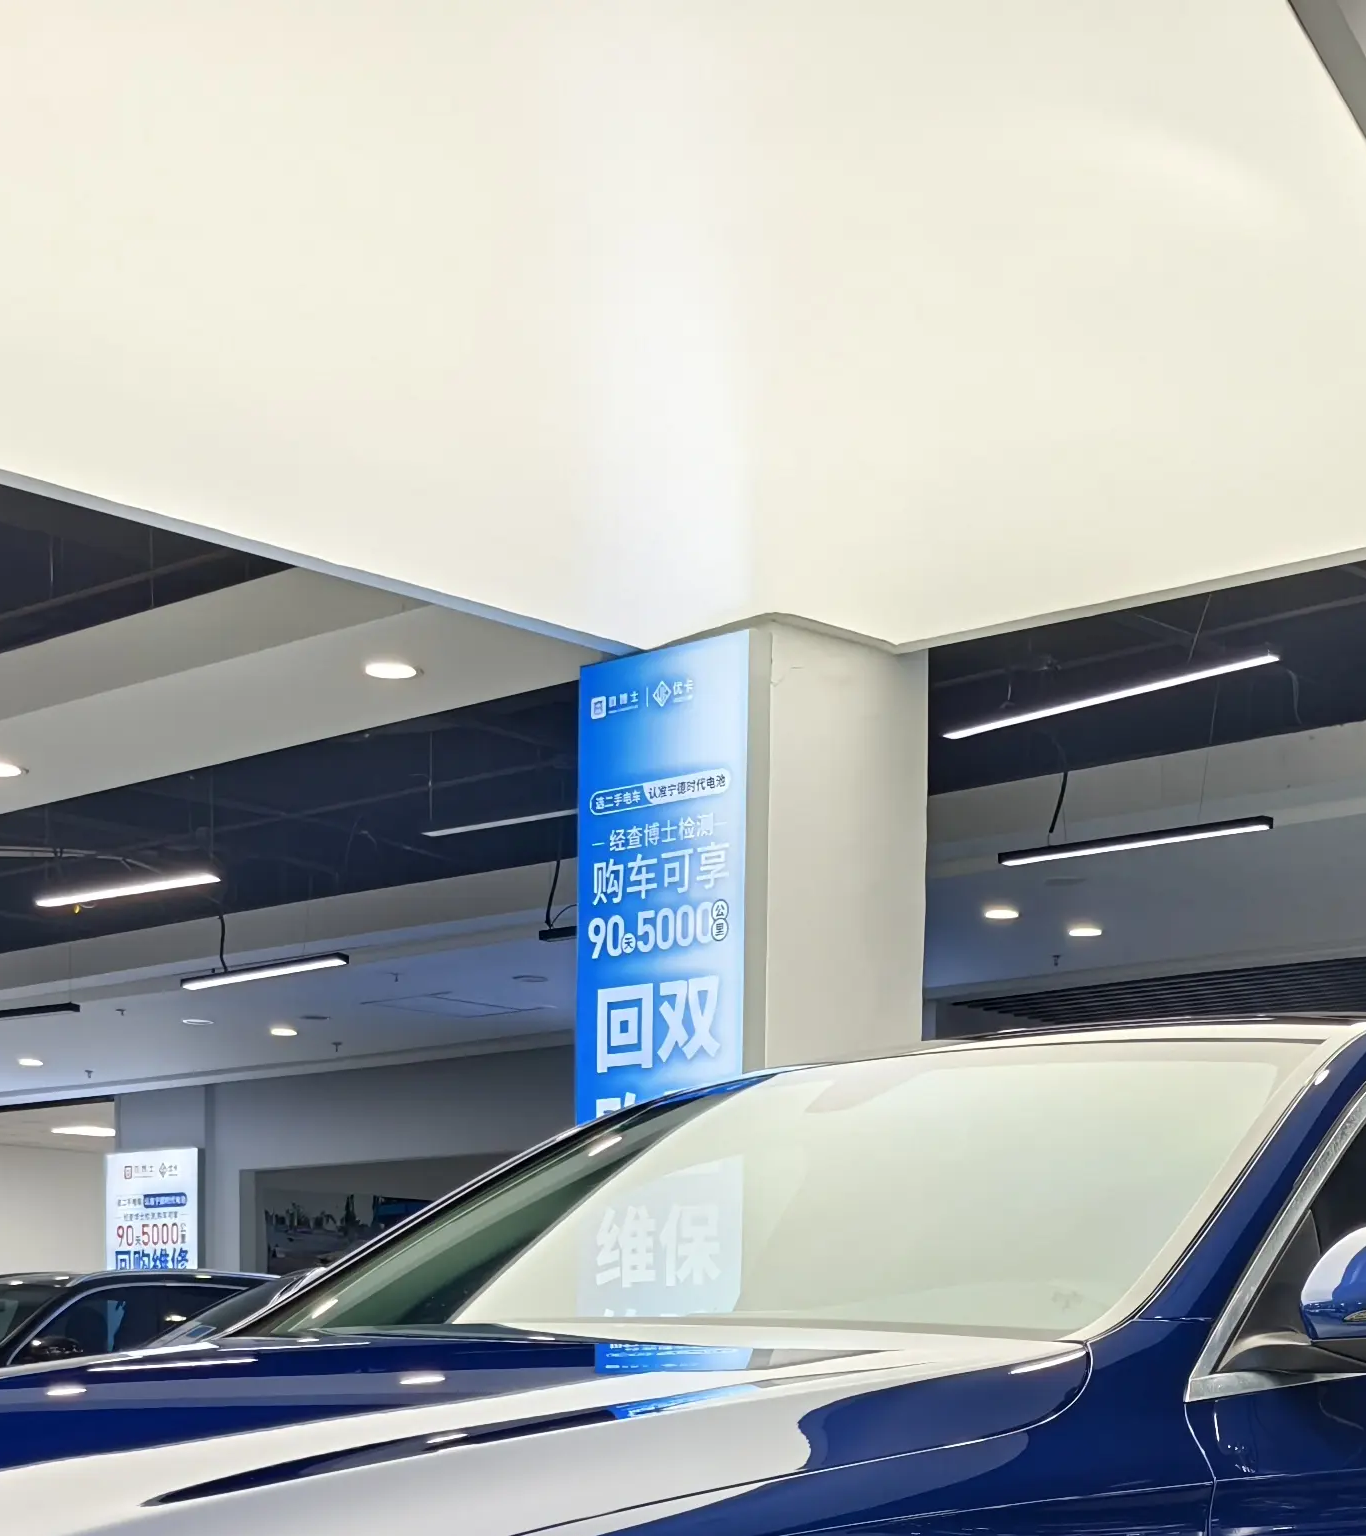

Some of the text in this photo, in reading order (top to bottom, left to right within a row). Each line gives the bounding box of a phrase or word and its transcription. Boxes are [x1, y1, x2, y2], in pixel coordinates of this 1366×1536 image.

[609, 812, 714, 852] 经查博士检测
[592, 841, 730, 906] 购车可享
